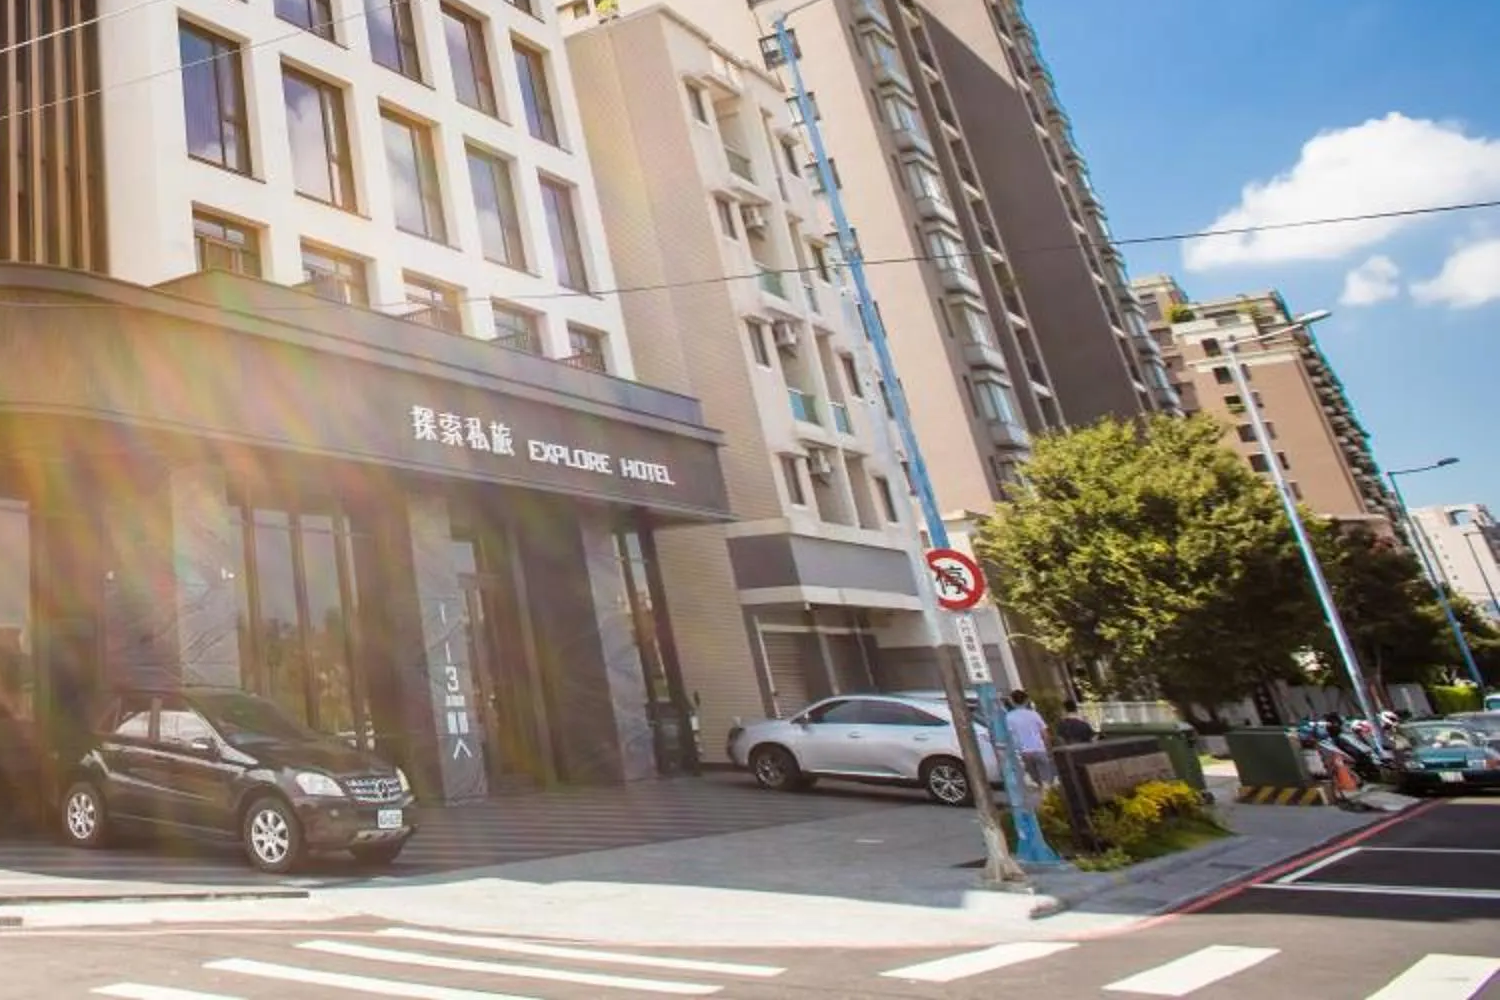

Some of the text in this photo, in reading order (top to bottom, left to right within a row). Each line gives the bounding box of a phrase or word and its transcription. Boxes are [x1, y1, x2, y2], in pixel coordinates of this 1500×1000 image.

[409, 405, 516, 457] 探索私旅
[528, 439, 676, 486] EXPLORE HOTEL
